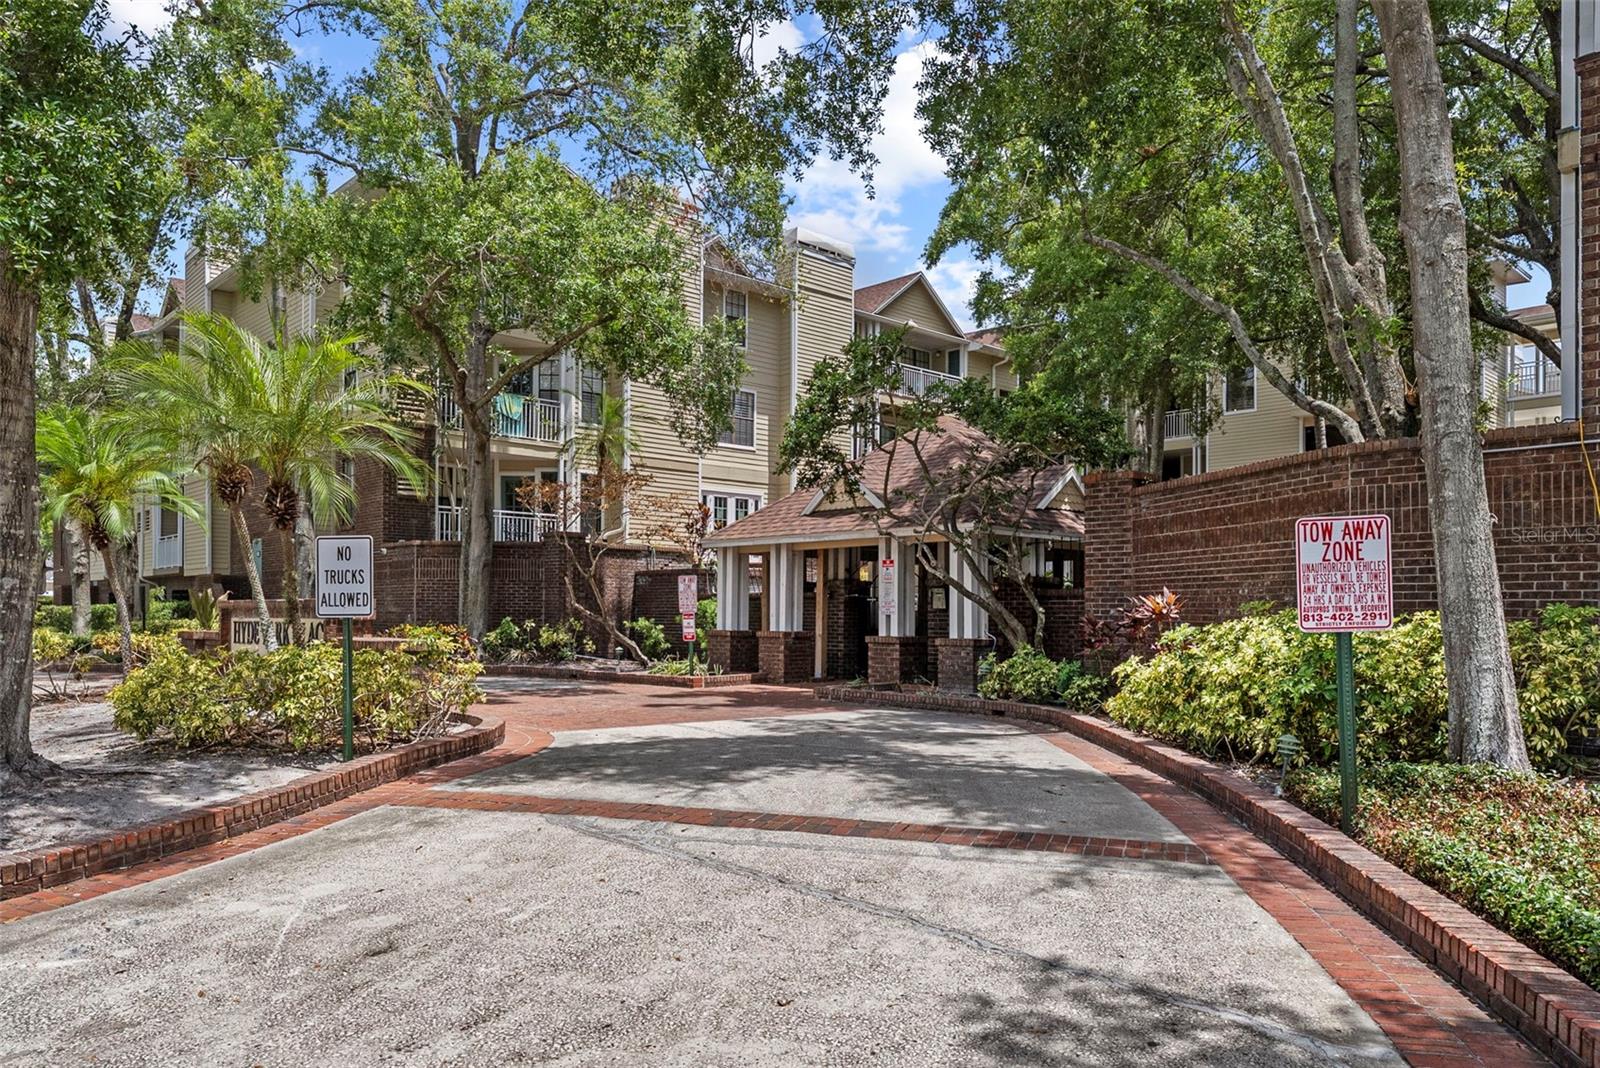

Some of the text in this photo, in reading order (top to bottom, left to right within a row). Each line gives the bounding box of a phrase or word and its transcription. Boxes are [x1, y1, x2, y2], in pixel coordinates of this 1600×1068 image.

[1301, 520, 1384, 542] TOW AWAY
[337, 546, 351, 561] NO
[1322, 541, 1365, 562] ZONE
[1302, 560, 1387, 574] UNAUTHORIZED VEHICLES
[324, 569, 365, 585] TRUCKS
[1302, 571, 1386, 584] OR VESSELS WILL BE TOWED
[1303, 582, 1386, 595] AWAY AT OWNERS EXPENSE
[321, 591, 369, 607] ALLOWED
[1304, 595, 1311, 606] 24
[1314, 594, 1325, 605] HRS
[1328, 594, 1332, 604] A
[1335, 594, 1345, 605] DAY
[1348, 594, 1352, 604] 7
[1354, 594, 1368, 604] DAYS
[1371, 593, 1375, 604] A
[1332, 605, 1352, 613] TOWING
[1361, 604, 1388, 612] RECOVERY
[1303, 612, 1388, 623] 813-402-2911
[233, 621, 260, 645] HYDE
